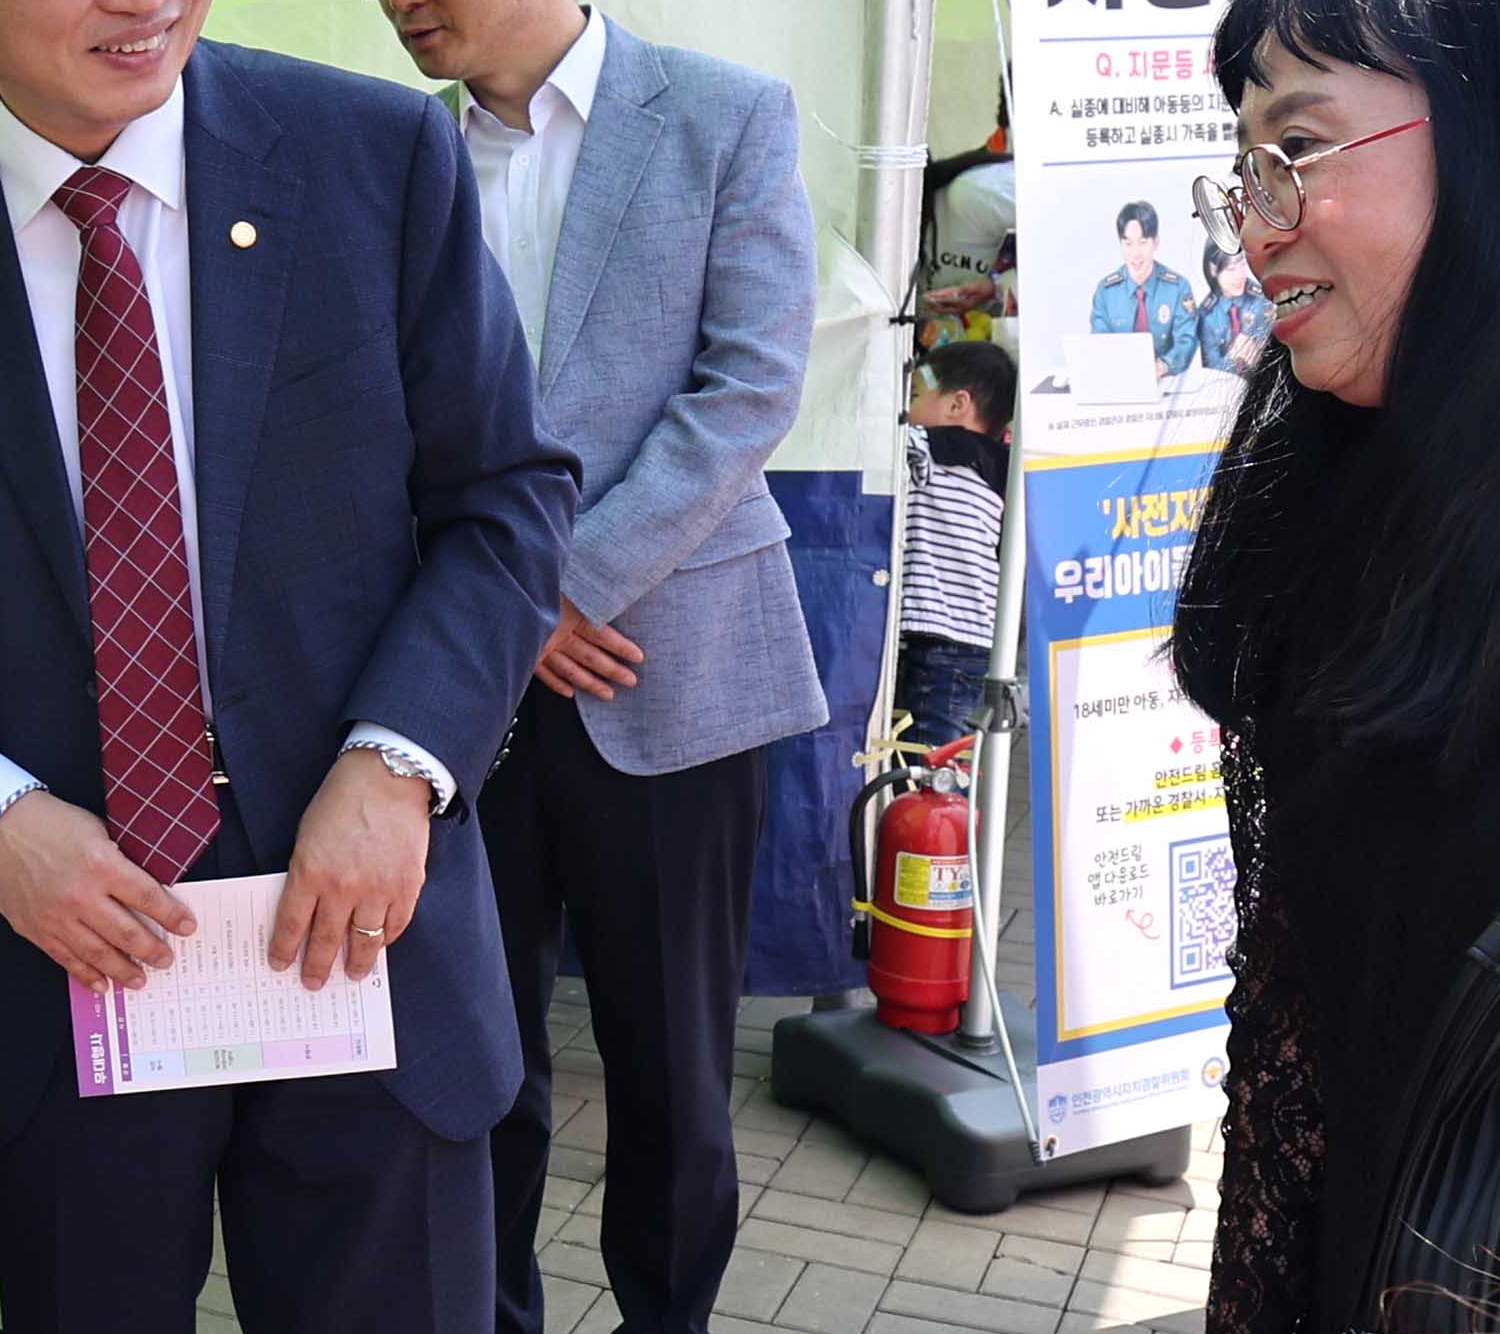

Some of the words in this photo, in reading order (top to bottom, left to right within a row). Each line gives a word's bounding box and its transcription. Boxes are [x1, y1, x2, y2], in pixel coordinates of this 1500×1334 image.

[1096, 52, 1120, 78] Q.
[1128, 49, 1193, 80] 지문등
[1050, 100, 1063, 116] A.
[1071, 98, 1109, 118] 실종에
[1112, 96, 1150, 115] 대비해
[1154, 93, 1204, 114] 아동등의
[1086, 127, 1136, 148] 등록하고
[1140, 124, 1178, 145] 실종시
[1181, 122, 1218, 142] 가족을
[1073, 696, 1131, 719] 18세미만
[1155, 763, 1207, 789] 안전드림
[1096, 805, 1122, 823] 또는
[1125, 796, 1165, 818] 가까운
[1093, 846, 1143, 867] 안전드림
[1104, 864, 1150, 886] 다운로드
[1094, 886, 1144, 907] 바로가기
